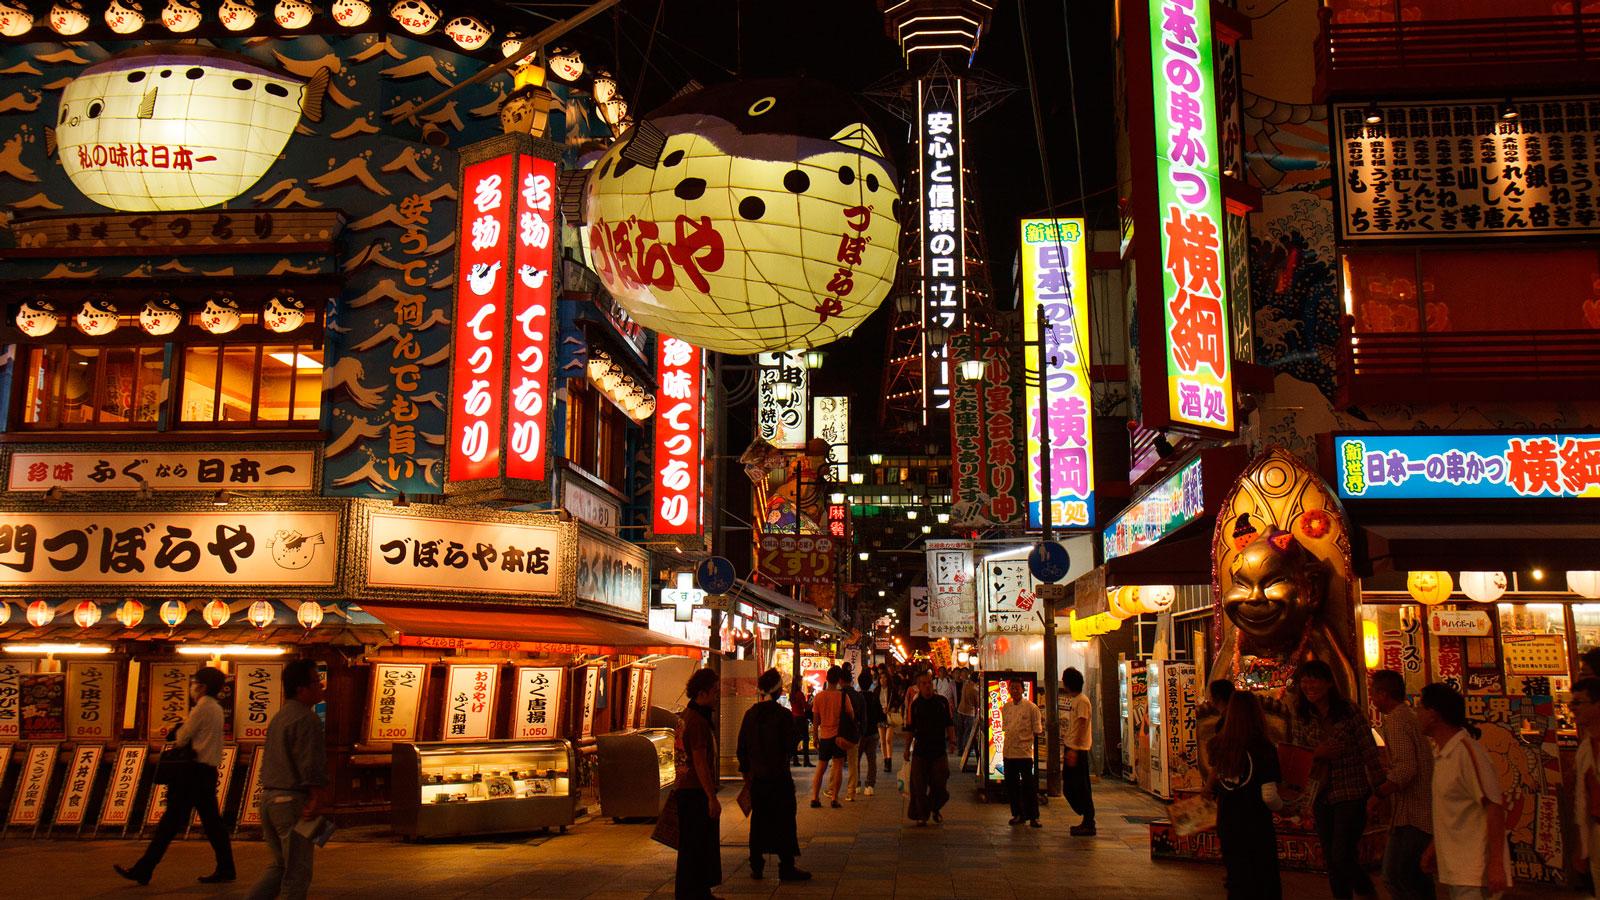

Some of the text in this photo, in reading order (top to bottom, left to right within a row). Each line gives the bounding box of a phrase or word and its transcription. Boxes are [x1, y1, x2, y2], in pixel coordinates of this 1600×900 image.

[1160, 0, 1207, 205] 本一の串かつ
[78, 144, 218, 171] 私の味は日本一
[590, 213, 725, 293] づぼらや
[1025, 223, 1080, 243] 新世界
[814, 204, 875, 323] づぼらや
[1165, 206, 1225, 378] 横綱
[461, 173, 502, 463] 名物 てっちり
[512, 304, 547, 463] てっちり
[1180, 383, 1226, 422] 酒処
[659, 337, 694, 527] 珍味てっちり
[28, 458, 296, 483] 珍味 ふぐなら日本一
[1343, 443, 1366, 494] 新世界
[1366, 439, 1600, 493] 日本一の串かつ 横綱
[379, 538, 551, 576] づぼらや本店
[762, 552, 830, 578] くすり
[451, 692, 469, 735] ふぐ料理
[471, 671, 489, 713] おみやげ
[526, 673, 549, 724] ふぐ唐揚
[77, 726, 102, 736] 840
[378, 728, 407, 737] 1,200
[522, 727, 548, 736] 1,050
[69, 750, 94, 807] 天丼定食
